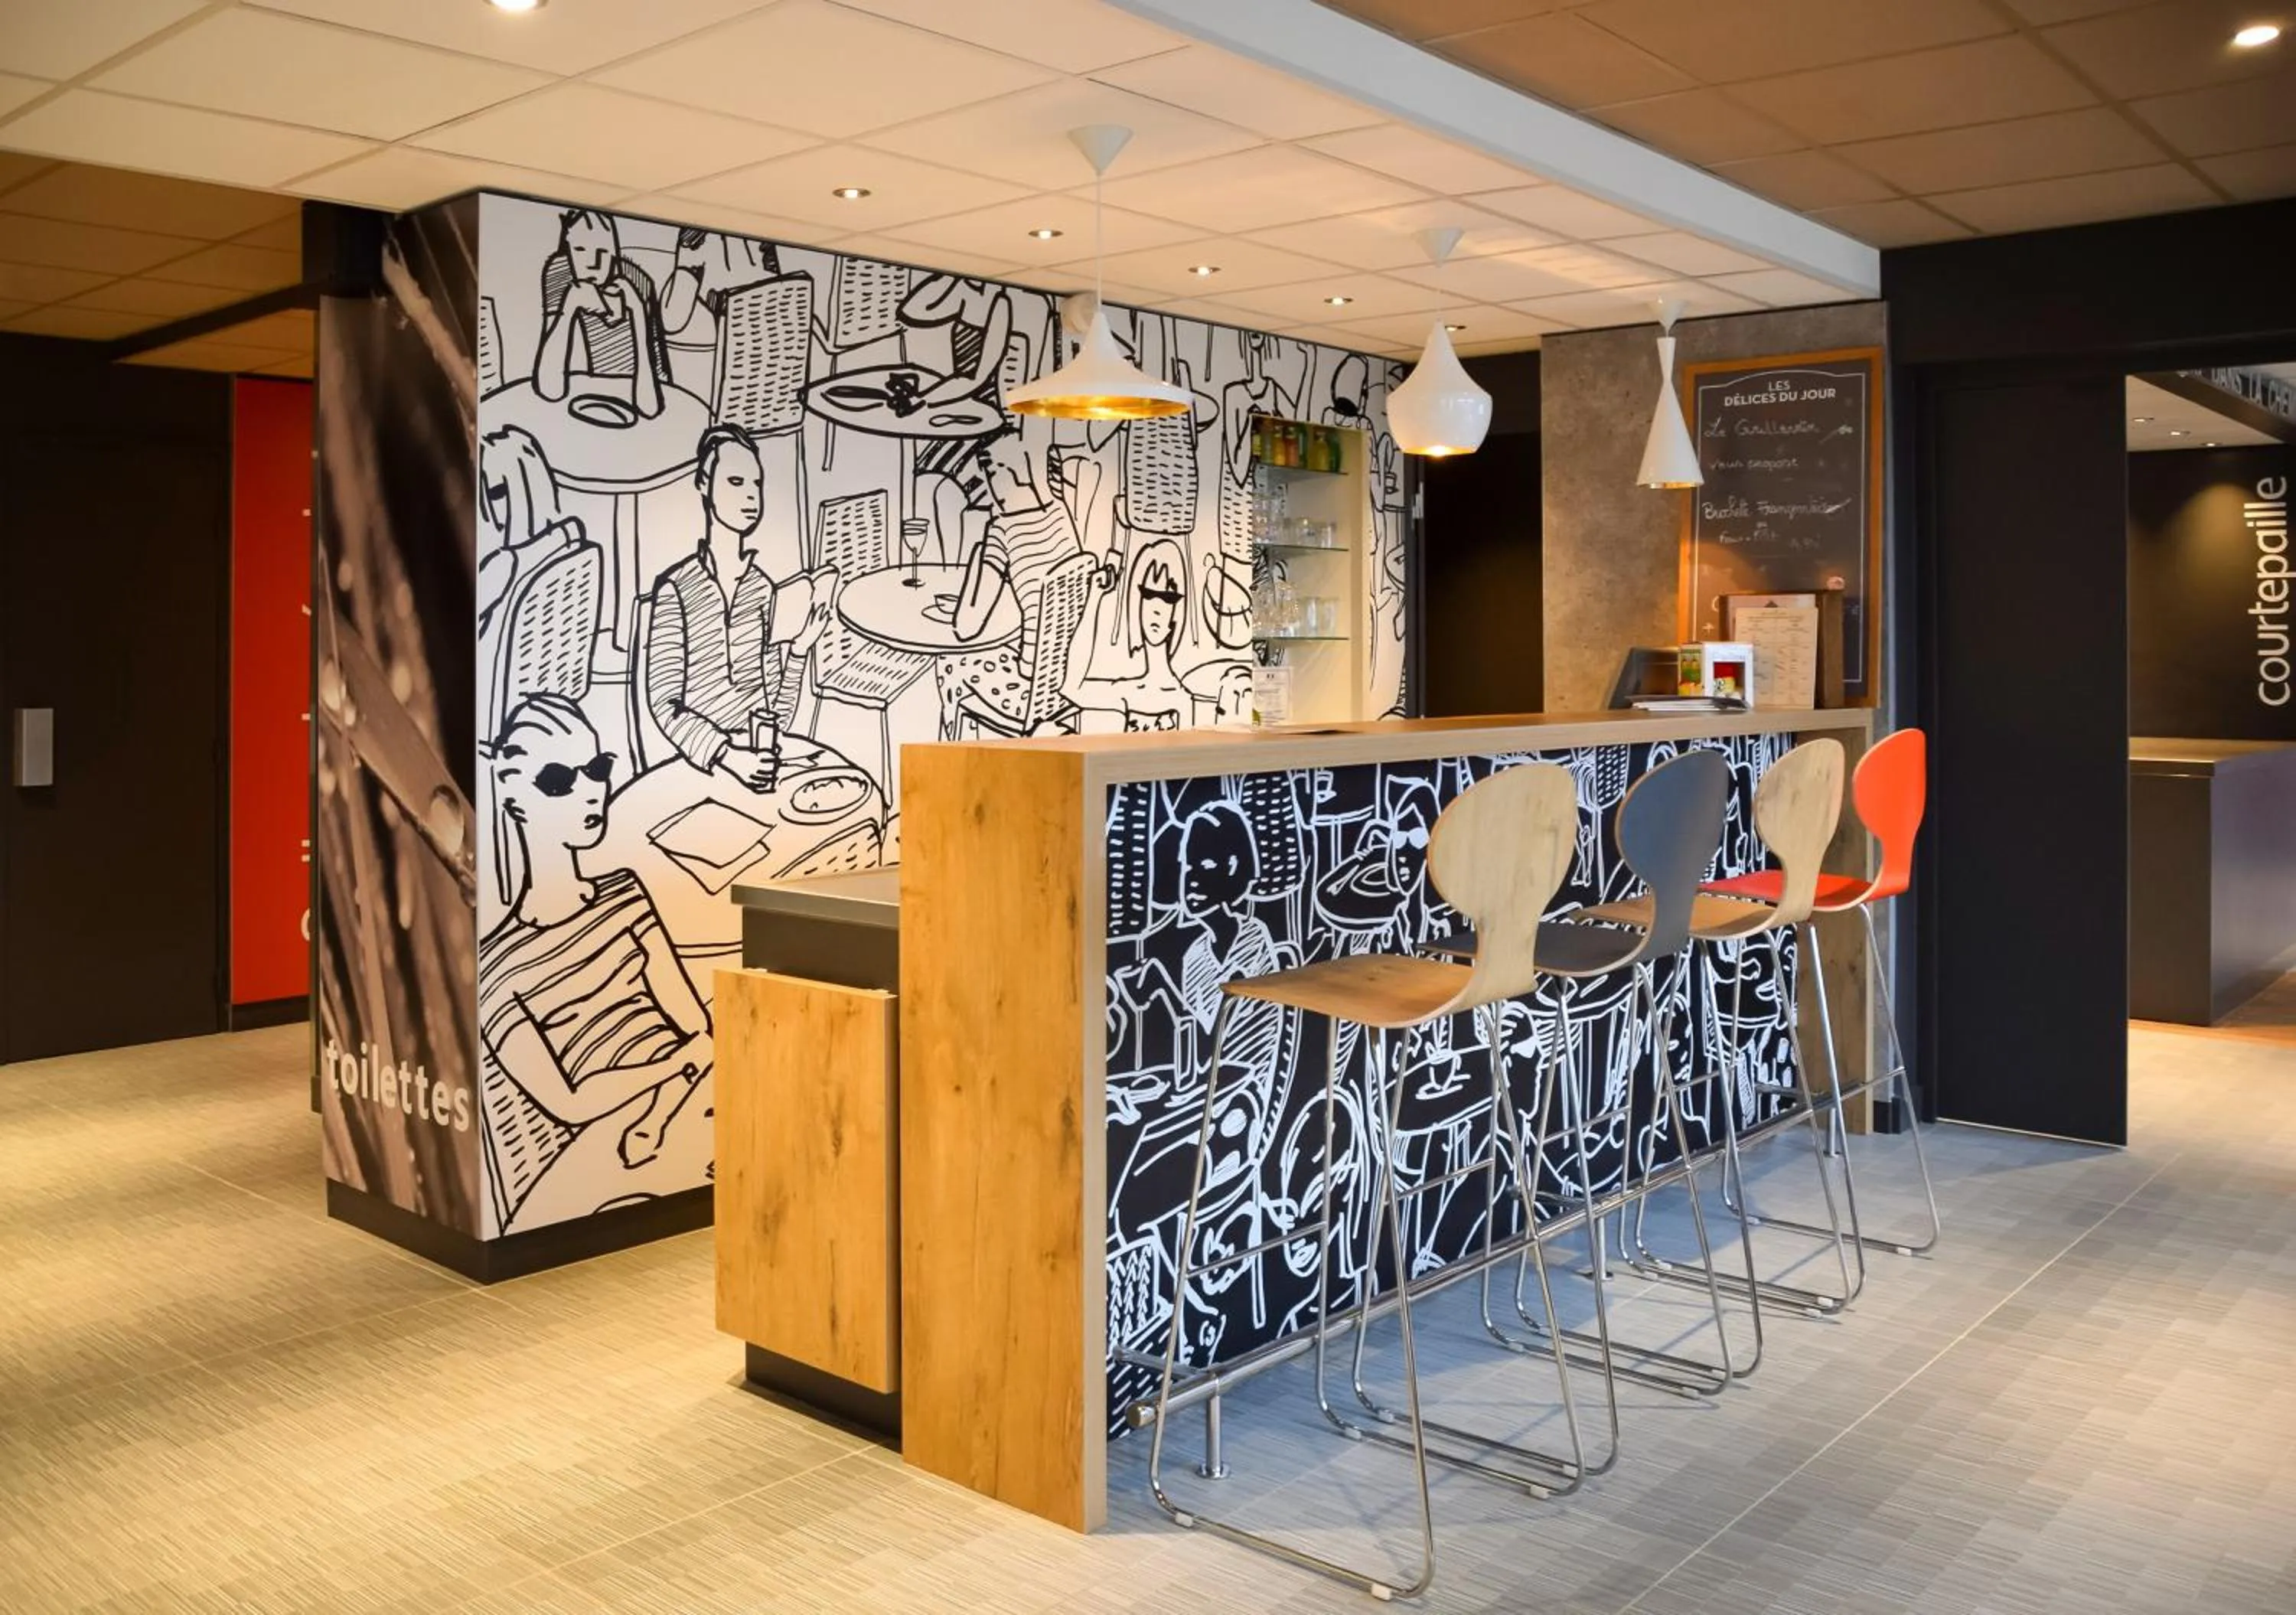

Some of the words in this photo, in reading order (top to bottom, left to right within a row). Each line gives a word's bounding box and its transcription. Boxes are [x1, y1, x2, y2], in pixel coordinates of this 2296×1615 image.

[1724, 392, 1776, 407] DÉLICES
[1779, 391, 1798, 403] DU
[1800, 388, 1837, 400] JOUR
[1769, 380, 1791, 392] LES
[2243, 475, 2296, 706] courtepaille
[325, 1039, 470, 1132] toilettes
